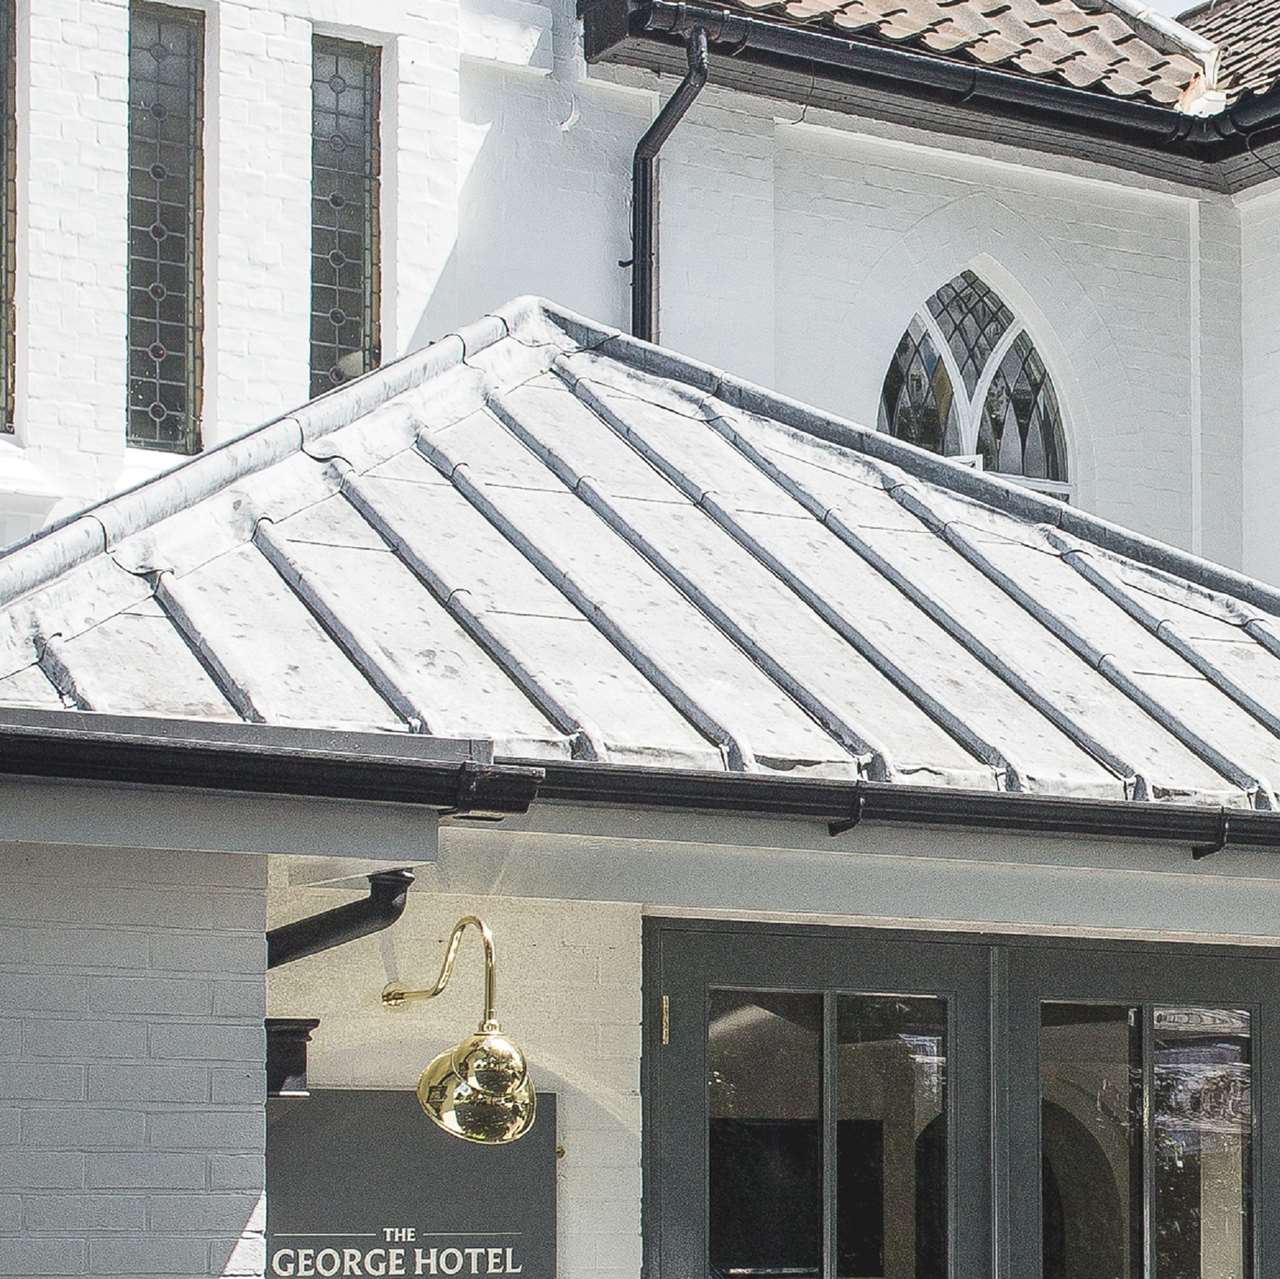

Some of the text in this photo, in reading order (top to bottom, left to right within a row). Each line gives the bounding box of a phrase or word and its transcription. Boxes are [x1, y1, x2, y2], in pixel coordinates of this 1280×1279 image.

[383, 1227, 416, 1242] THE
[271, 1247, 523, 1277] GEORGE HOTEL
